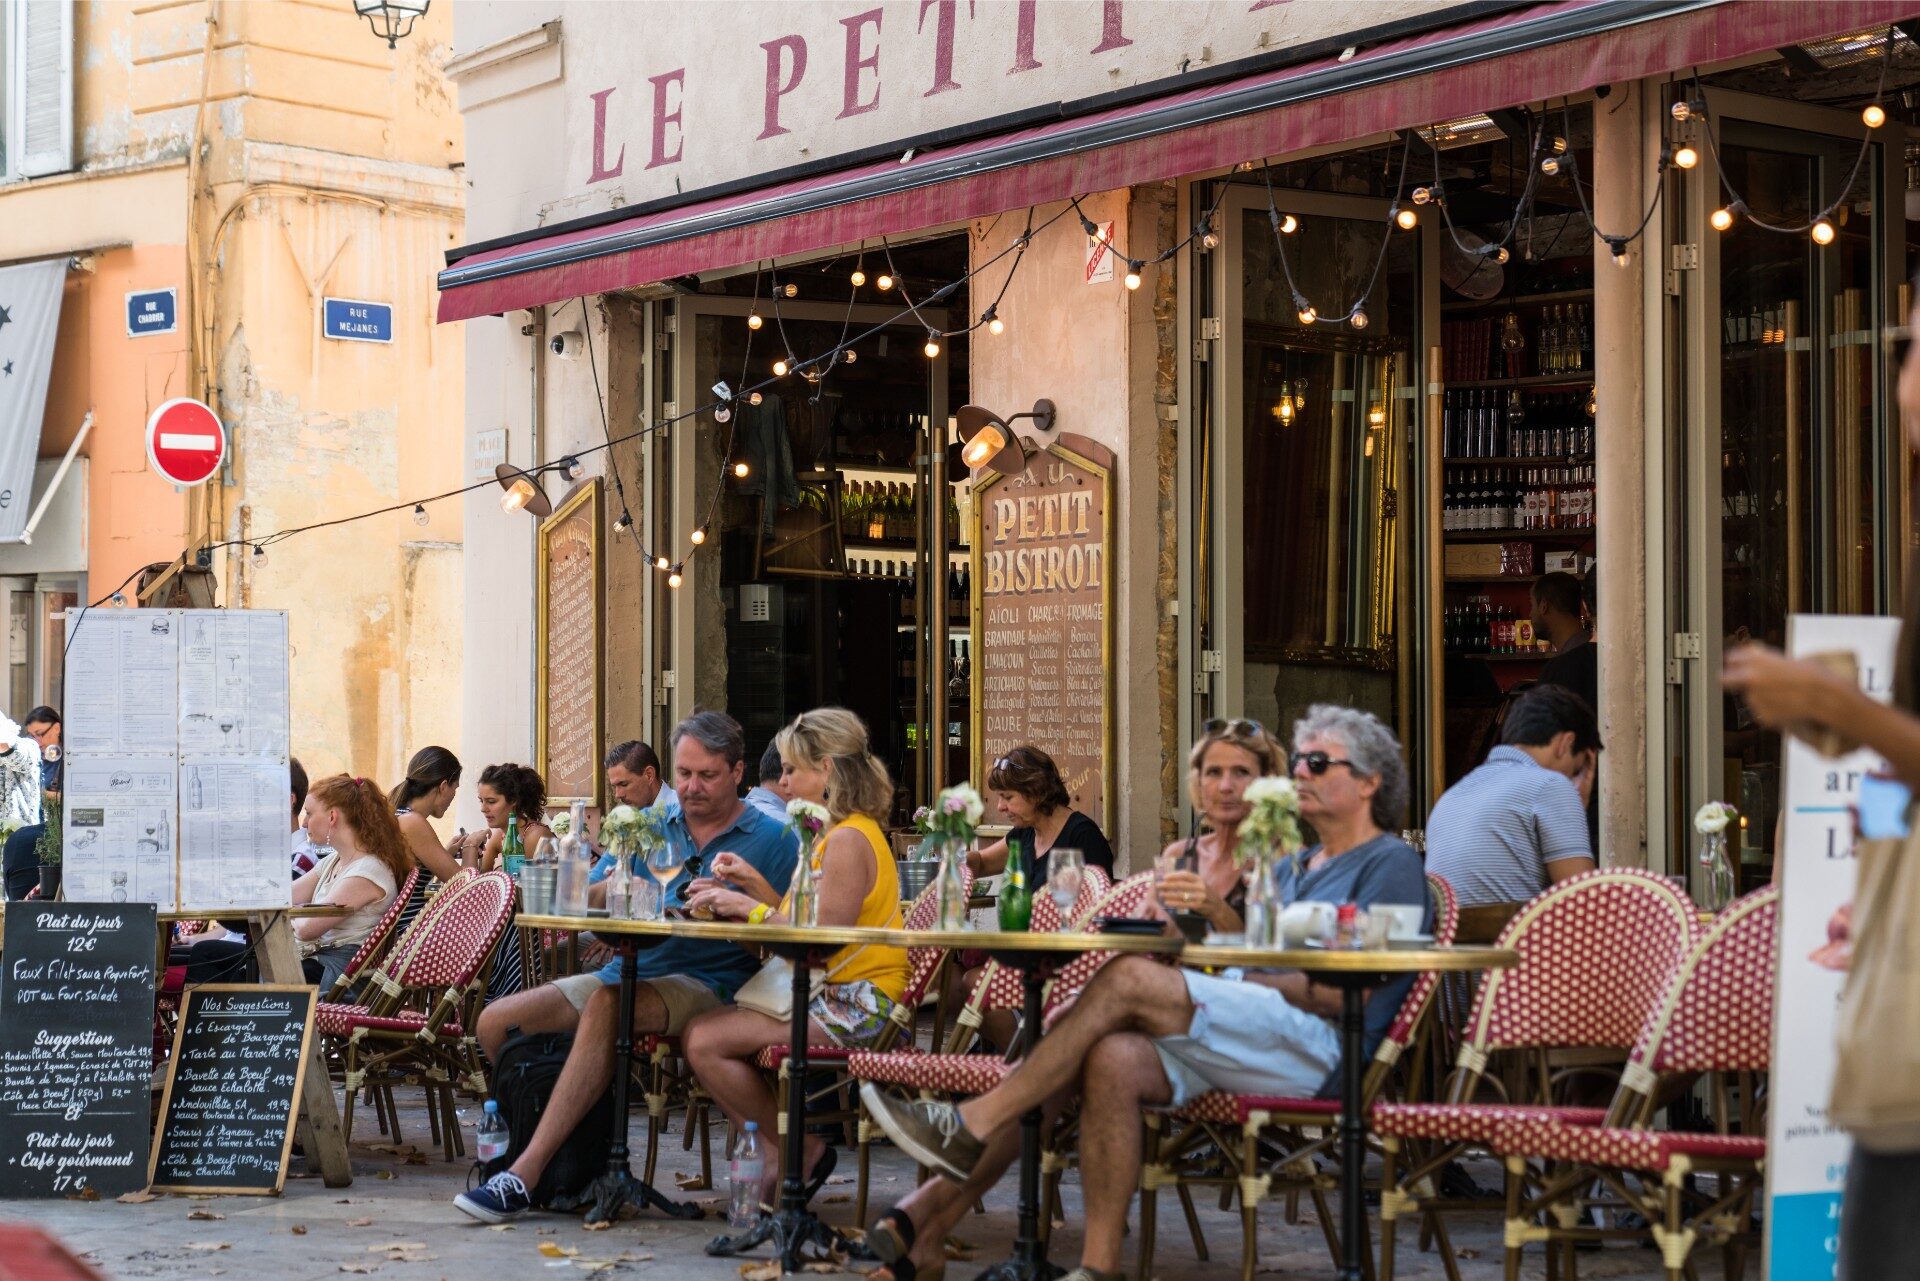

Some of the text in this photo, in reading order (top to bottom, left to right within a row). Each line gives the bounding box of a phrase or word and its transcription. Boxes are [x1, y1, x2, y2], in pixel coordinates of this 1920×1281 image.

[586, 68, 685, 185] LE
[350, 308, 368, 318] RUE
[339, 321, 378, 335] MEJANES
[994, 490, 1093, 544] PETIT
[984, 543, 1103, 596] BISTROT
[988, 604, 1019, 624] AÏOLI
[984, 630, 1026, 647] BRANDADE
[987, 716, 1022, 732] DAUBE
[36, 913, 123, 936] Plat du jour
[66, 936, 97, 952] 12€
[201, 998, 222, 1011] Nos
[195, 1022, 204, 1033] 6
[207, 1020, 257, 1035] Escargots
[34, 1029, 114, 1052] Suggestion
[221, 1033, 238, 1044] de
[188, 1047, 217, 1060] Tarte
[220, 1051, 236, 1059] au
[183, 1067, 219, 1081] Bavette
[221, 1067, 236, 1079] de
[189, 1081, 218, 1093] sauce
[172, 1125, 203, 1137] Souris
[26, 1132, 115, 1155] Plat du jour
[20, 1151, 55, 1172] Café
[55, 1150, 134, 1175] gourmand
[167, 1153, 188, 1165] Côte
[191, 1153, 205, 1165] de
